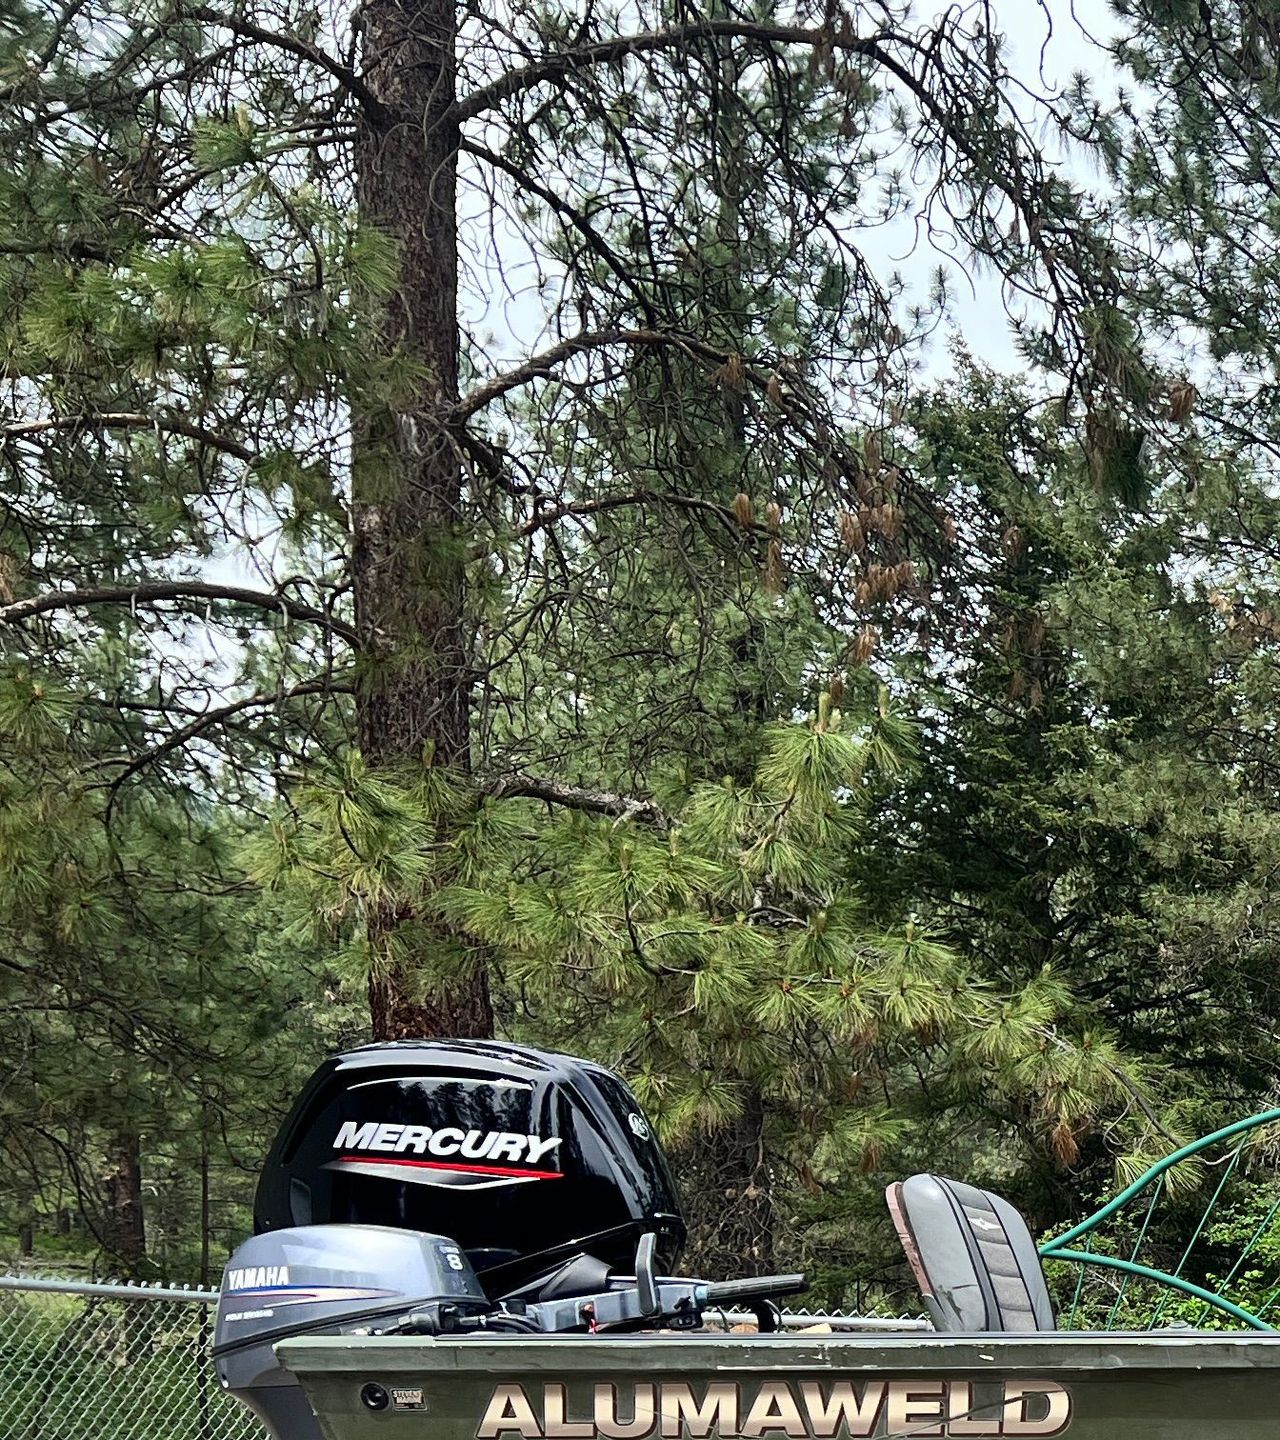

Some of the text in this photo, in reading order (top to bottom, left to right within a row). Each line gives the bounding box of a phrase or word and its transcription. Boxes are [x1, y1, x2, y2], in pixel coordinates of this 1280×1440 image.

[333, 1121, 562, 1164] MERCURY
[228, 1266, 288, 1290] YAMAHA
[446, 1254, 463, 1270] 8
[474, 1381, 1072, 1440] ALUMAWELD
